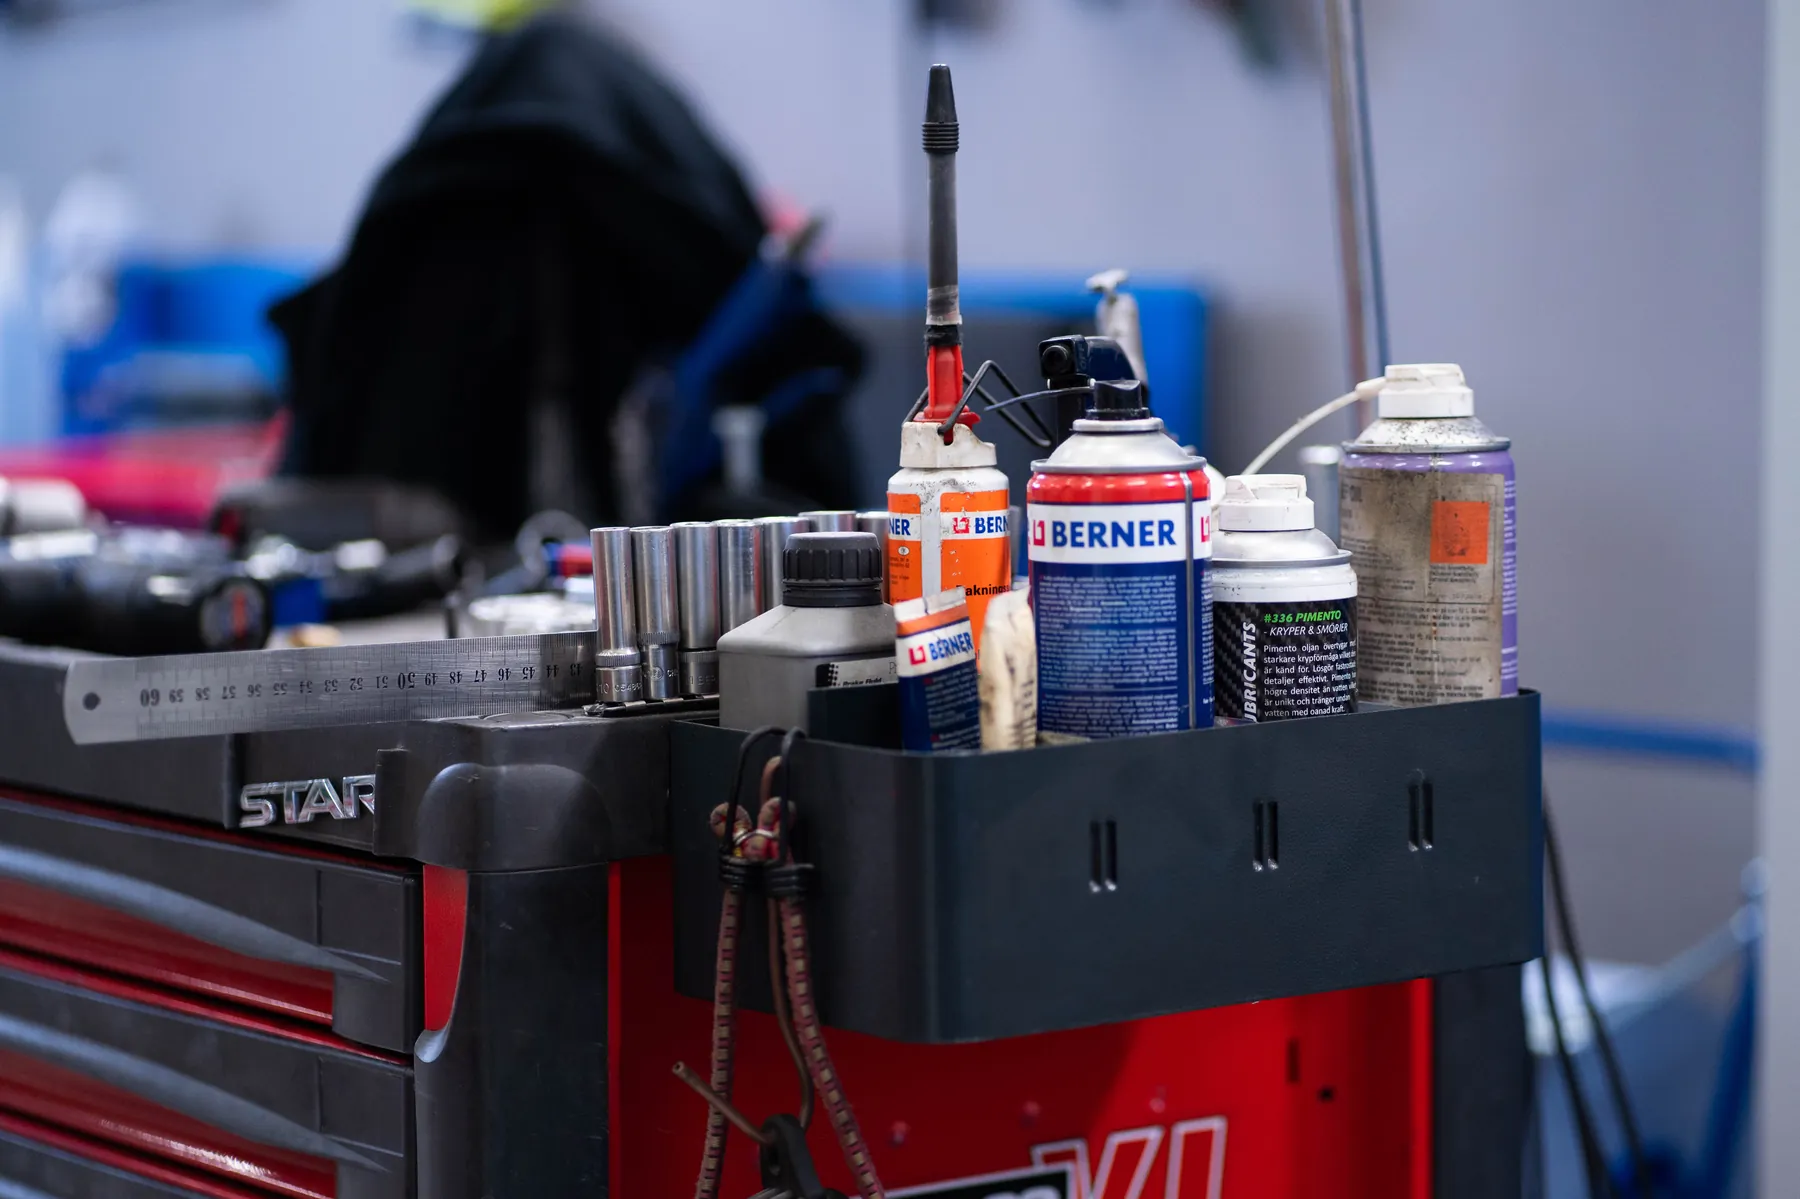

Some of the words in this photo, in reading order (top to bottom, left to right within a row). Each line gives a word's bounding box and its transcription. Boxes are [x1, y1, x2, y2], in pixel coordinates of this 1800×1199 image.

[1051, 520, 1177, 547] BERNER
[1264, 613, 1293, 623] #336
[1295, 610, 1342, 622] PIMENTO
[1269, 625, 1306, 636] KRYPER
[1307, 625, 1315, 635] &
[1316, 622, 1349, 634] SMÖRJER
[929, 632, 973, 661] BERNER
[1263, 644, 1297, 653] Pimento
[1301, 644, 1320, 653] oljan
[1263, 655, 1296, 664] starkare
[1297, 653, 1339, 663] krypförmåga
[474, 669, 488, 683] 47
[498, 667, 512, 681] 46
[522, 666, 536, 680] 45
[546, 664, 559, 679] 44
[569, 662, 583, 677] 43
[1264, 667, 1273, 675] är
[1275, 666, 1295, 674] känd
[1298, 665, 1310, 673] för.
[1313, 664, 1334, 673] Lösgör
[350, 677, 364, 691] 52
[376, 675, 389, 689] 51
[397, 671, 416, 690] 50
[424, 672, 438, 686] 49
[449, 670, 463, 684] 48
[1264, 676, 1295, 686] detaljer
[1298, 675, 1329, 684] effektivt.
[1331, 672, 1351, 681] Pimento
[221, 685, 237, 700] 57
[247, 683, 262, 698] 56
[273, 681, 288, 696] 55
[324, 678, 339, 693] 53
[1264, 688, 1288, 697] högre
[1290, 686, 1320, 695] densitet
[1322, 685, 1331, 693] än
[1332, 684, 1348, 692] vatten
[139, 688, 160, 708] 60
[168, 688, 184, 703] 59
[195, 687, 211, 701] 58
[1274, 698, 1295, 706] unikt
[1296, 697, 1310, 705] och
[1311, 696, 1335, 705] tränger
[1335, 694, 1351, 702] undan
[1264, 709, 1290, 717] vatten
[1291, 708, 1308, 716] med
[1310, 706, 1331, 715] oanad
[1331, 704, 1346, 713] kraft.
[239, 774, 376, 828] STAR
